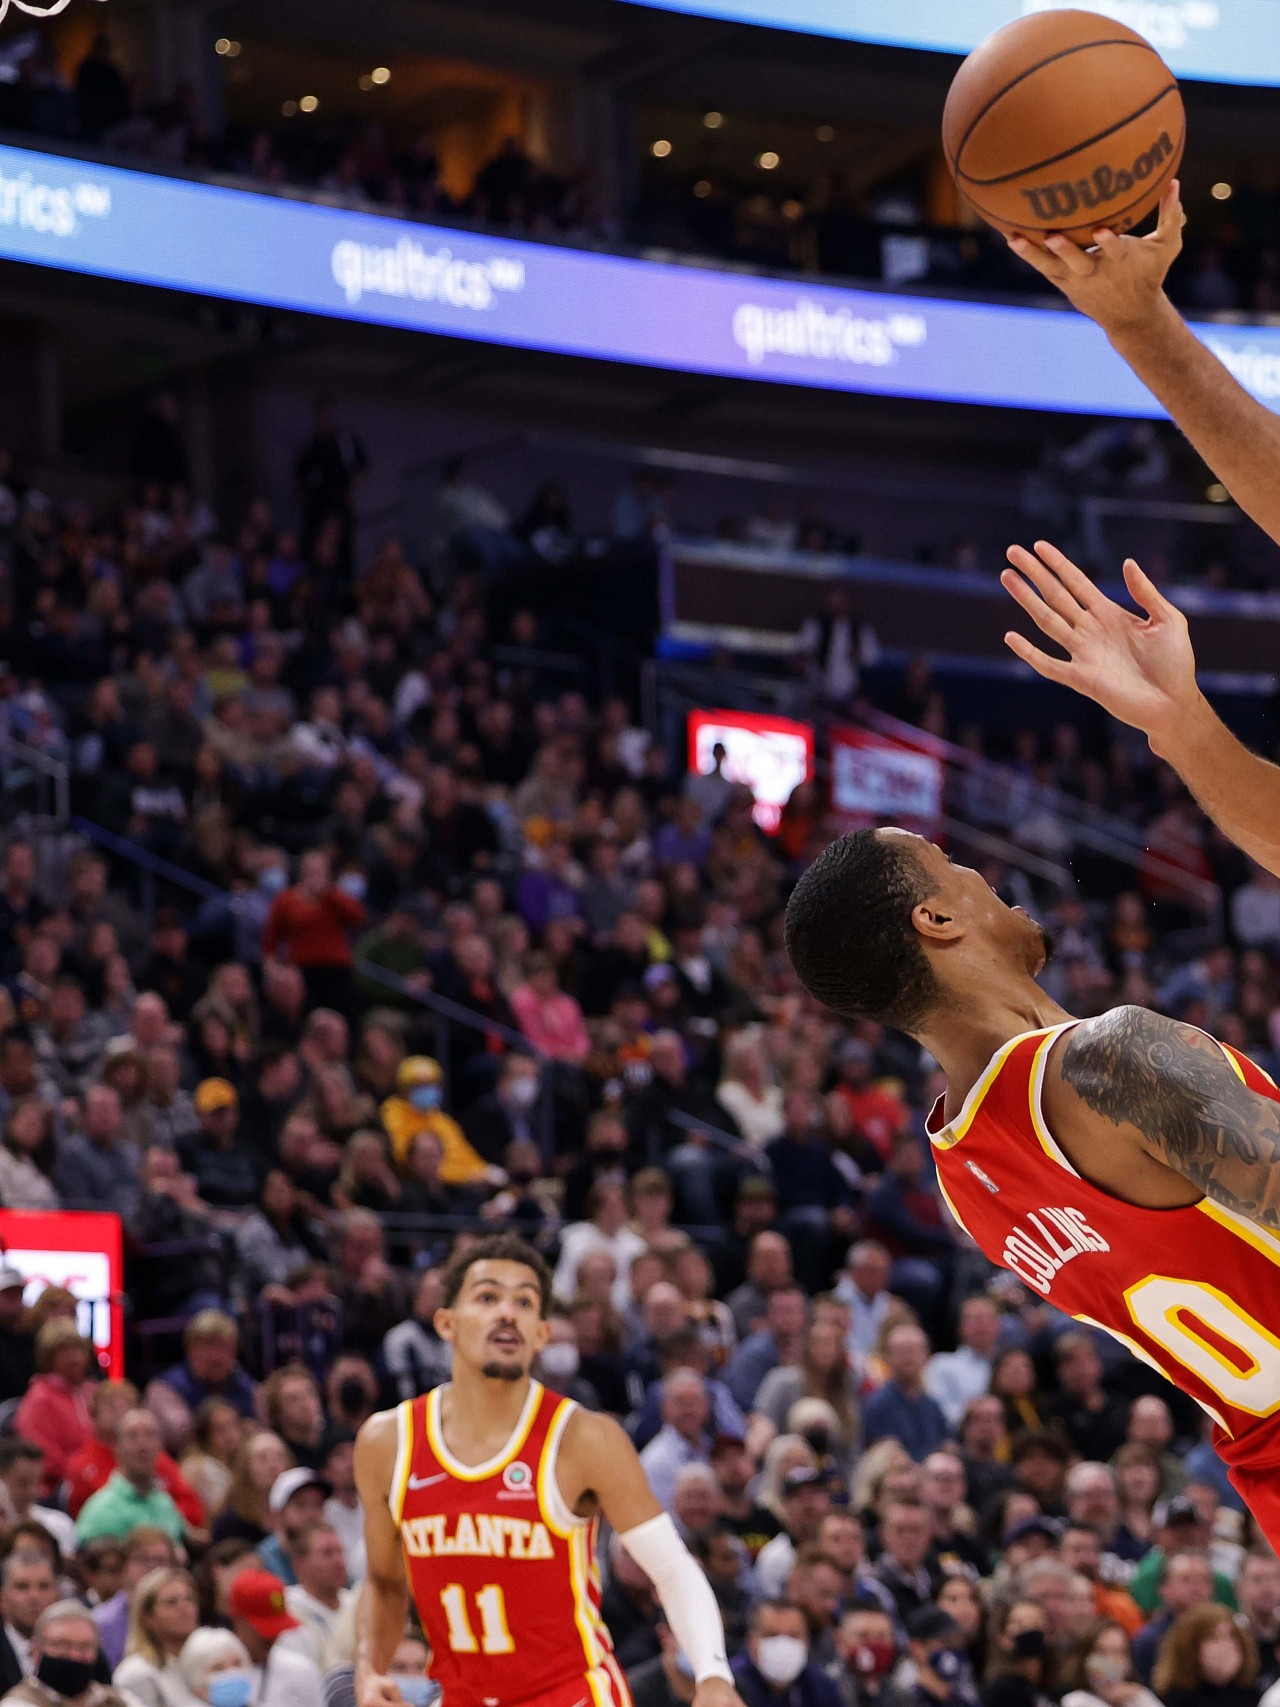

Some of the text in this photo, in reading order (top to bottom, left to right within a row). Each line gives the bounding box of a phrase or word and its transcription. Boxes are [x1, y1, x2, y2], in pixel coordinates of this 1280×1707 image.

[1021, 131, 1174, 221] Wilson
[1002, 1206, 1110, 1295] COLLINS
[440, 1582, 517, 1656] 11
